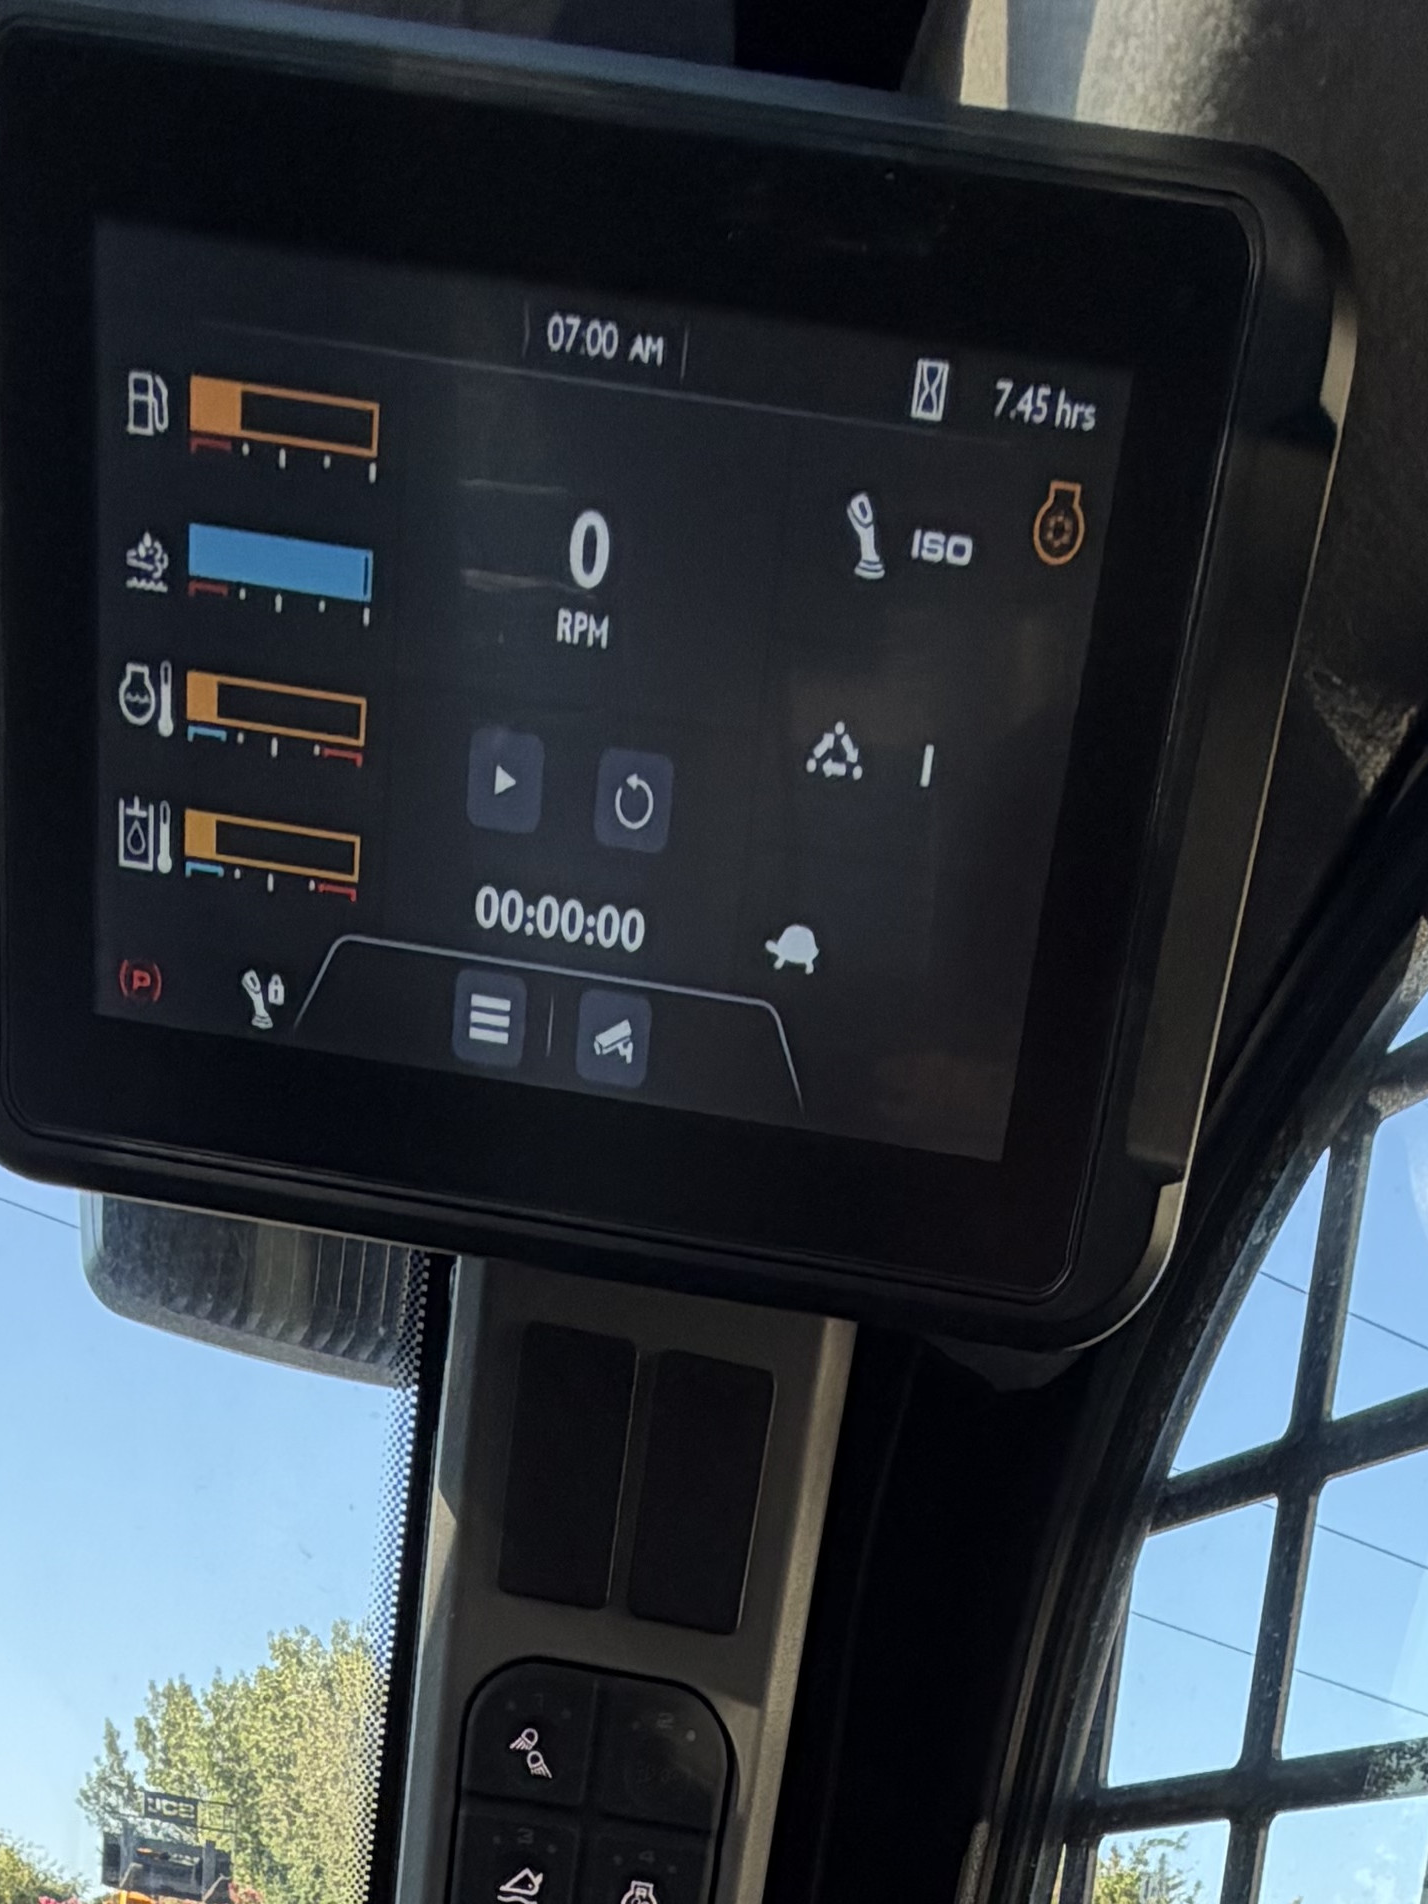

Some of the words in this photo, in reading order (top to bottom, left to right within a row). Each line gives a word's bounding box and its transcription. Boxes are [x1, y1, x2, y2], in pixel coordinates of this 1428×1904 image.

[547, 312, 619, 360] 07:00
[628, 333, 664, 367] AM
[994, 377, 1051, 424] 7.45
[1055, 387, 1096, 431] hrs
[570, 510, 610, 589] 0
[911, 529, 973, 566] ISO
[556, 608, 609, 649] RPM
[475, 885, 645, 952] 00:00:00
[147, 1797, 195, 1819] JCB
